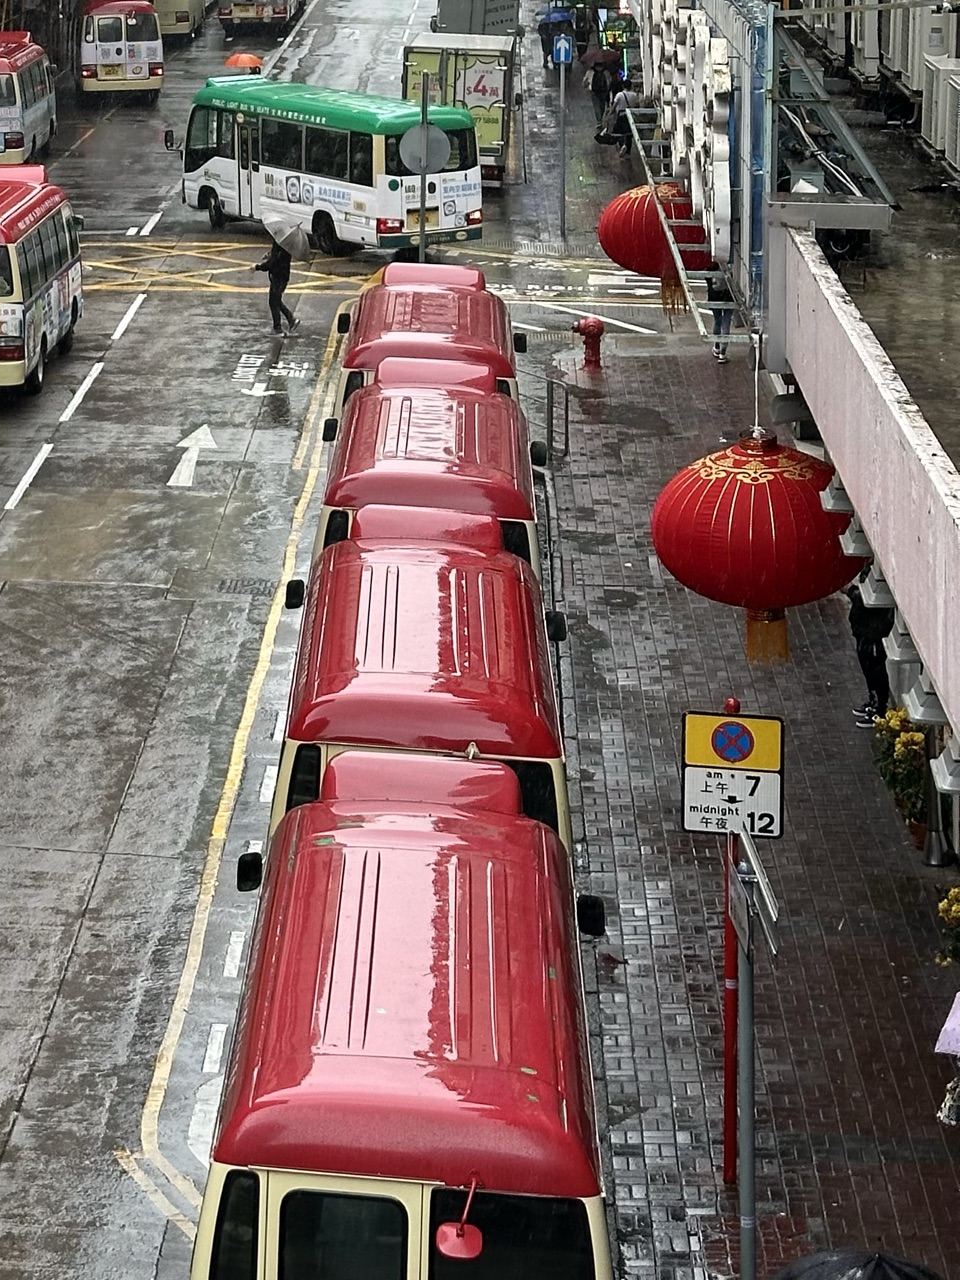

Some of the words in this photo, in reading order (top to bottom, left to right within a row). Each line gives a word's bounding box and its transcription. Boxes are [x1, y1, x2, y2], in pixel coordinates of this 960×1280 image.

[700, 780, 729, 795] 上午
[706, 771, 723, 779] am
[745, 776, 761, 797] 7
[689, 804, 740, 816] midnight
[747, 811, 775, 834] 12
[700, 816, 728, 830] 午夜
